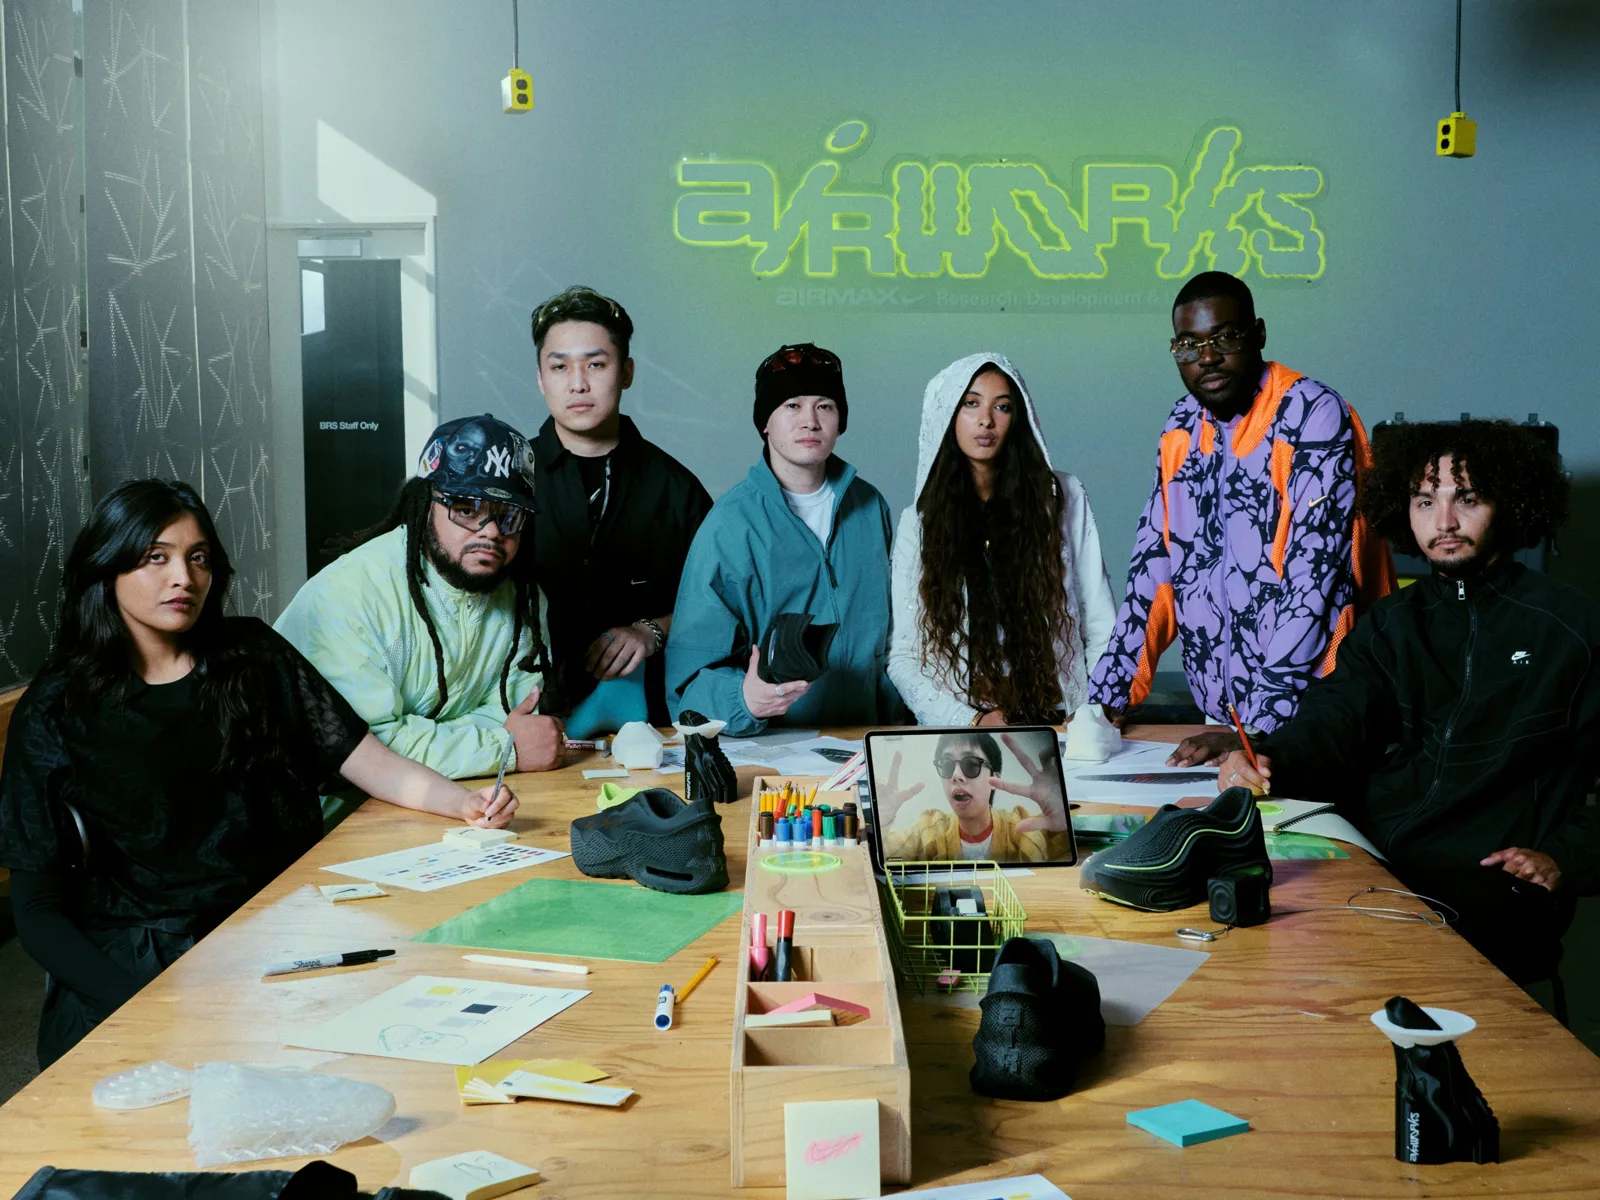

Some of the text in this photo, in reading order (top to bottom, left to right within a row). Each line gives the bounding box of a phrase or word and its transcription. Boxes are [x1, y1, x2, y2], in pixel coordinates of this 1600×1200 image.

[319, 421, 379, 432] BRS Staff Only
[483, 444, 511, 479] NY
